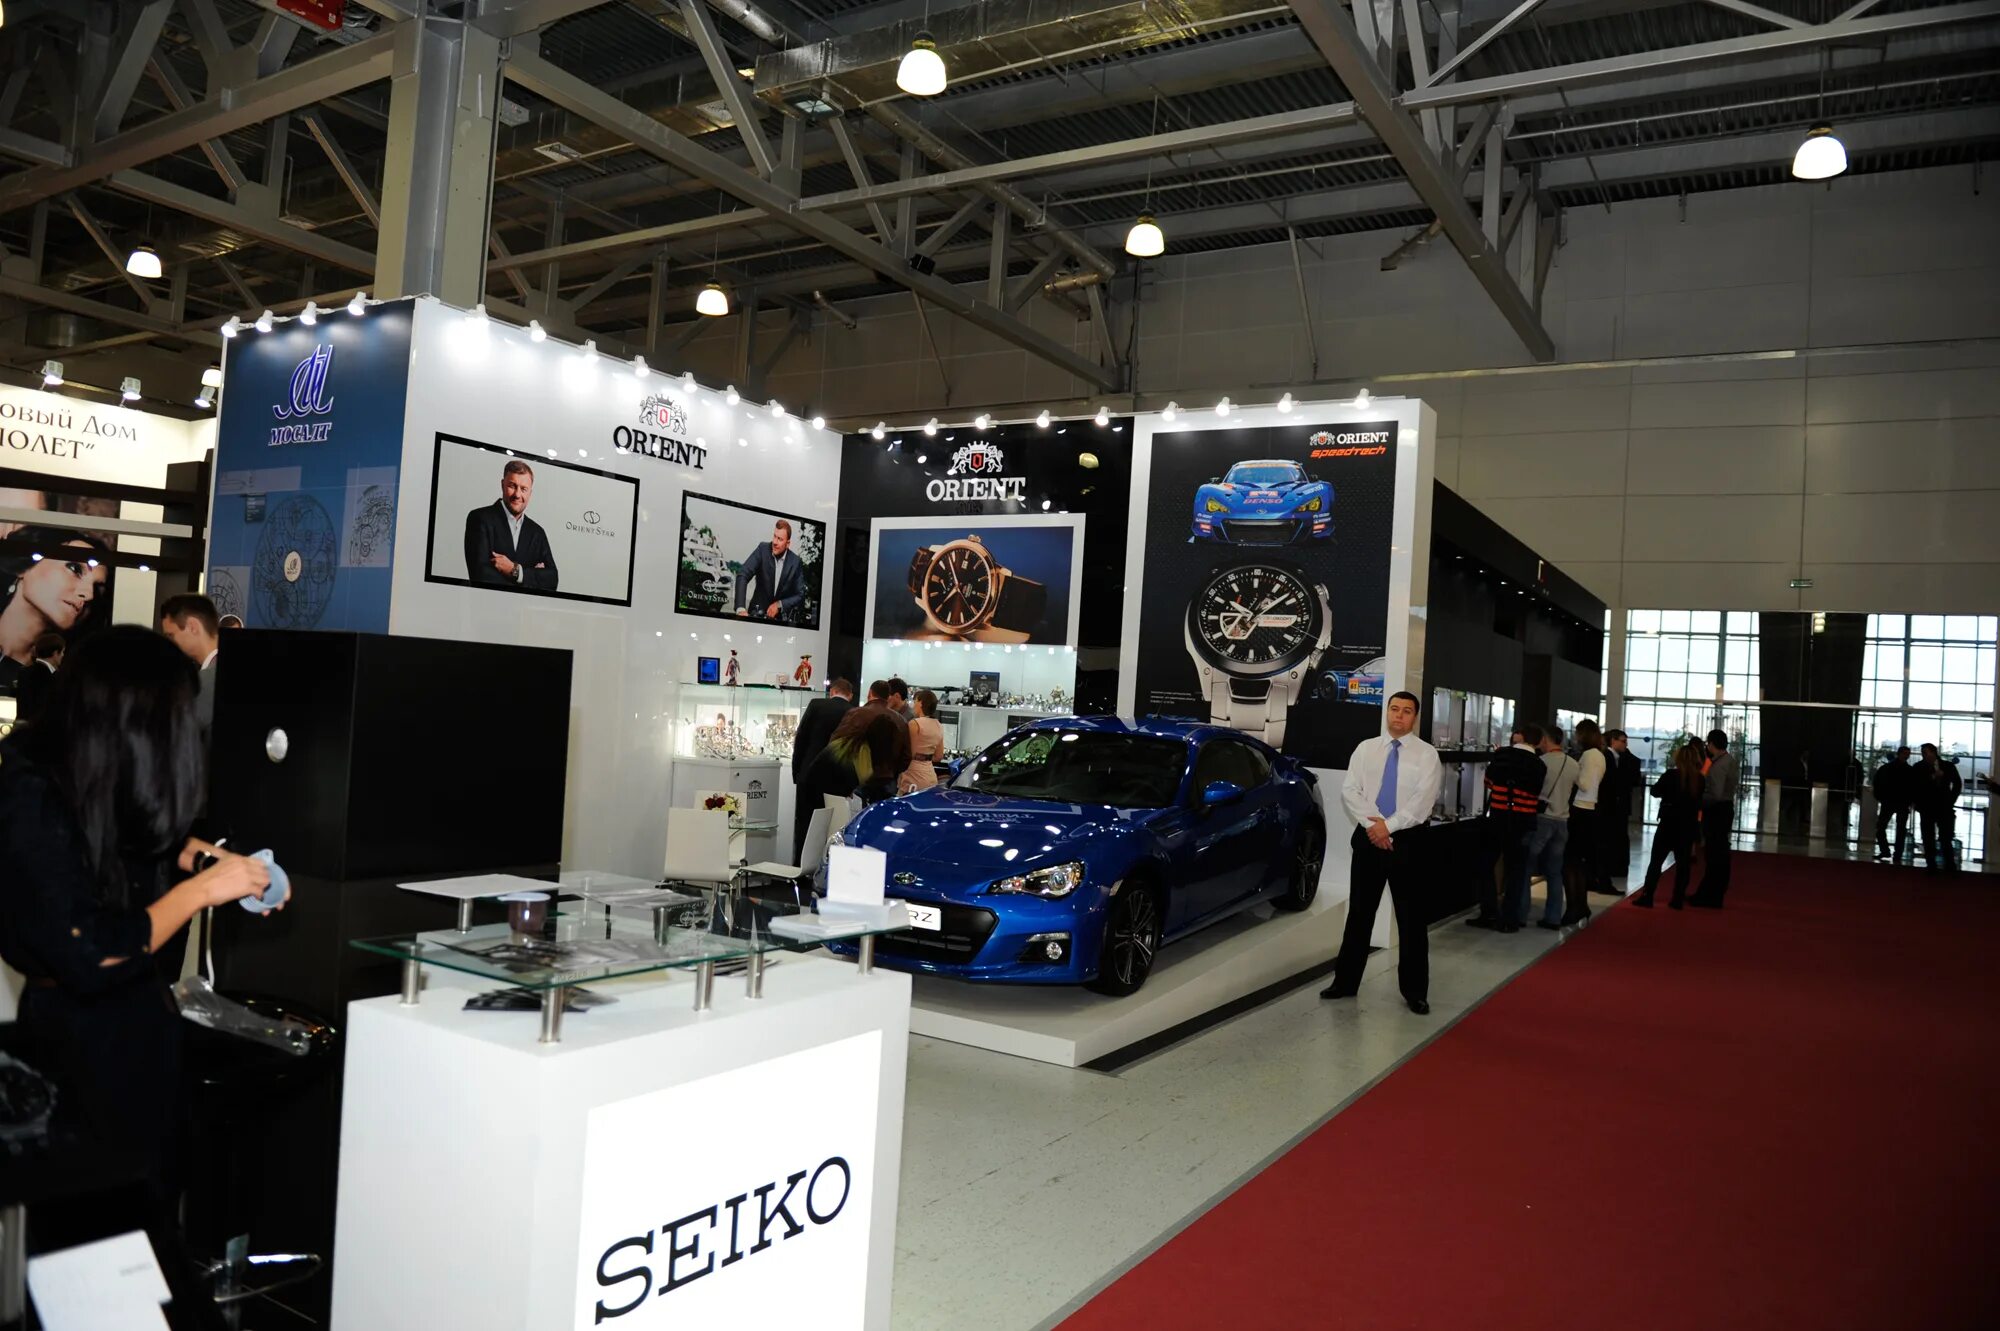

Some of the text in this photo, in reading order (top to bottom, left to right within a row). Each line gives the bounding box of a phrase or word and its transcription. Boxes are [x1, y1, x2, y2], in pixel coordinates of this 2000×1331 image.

[1337, 432, 1389, 444] ORIENT
[613, 425, 707, 470] ORIENT
[926, 477, 1026, 502] ORIENT
[1359, 687, 1383, 696] BRZ
[746, 791, 767, 800] RIENT
[909, 910, 932, 923] RZ
[595, 1156, 851, 1326] SEIKO
